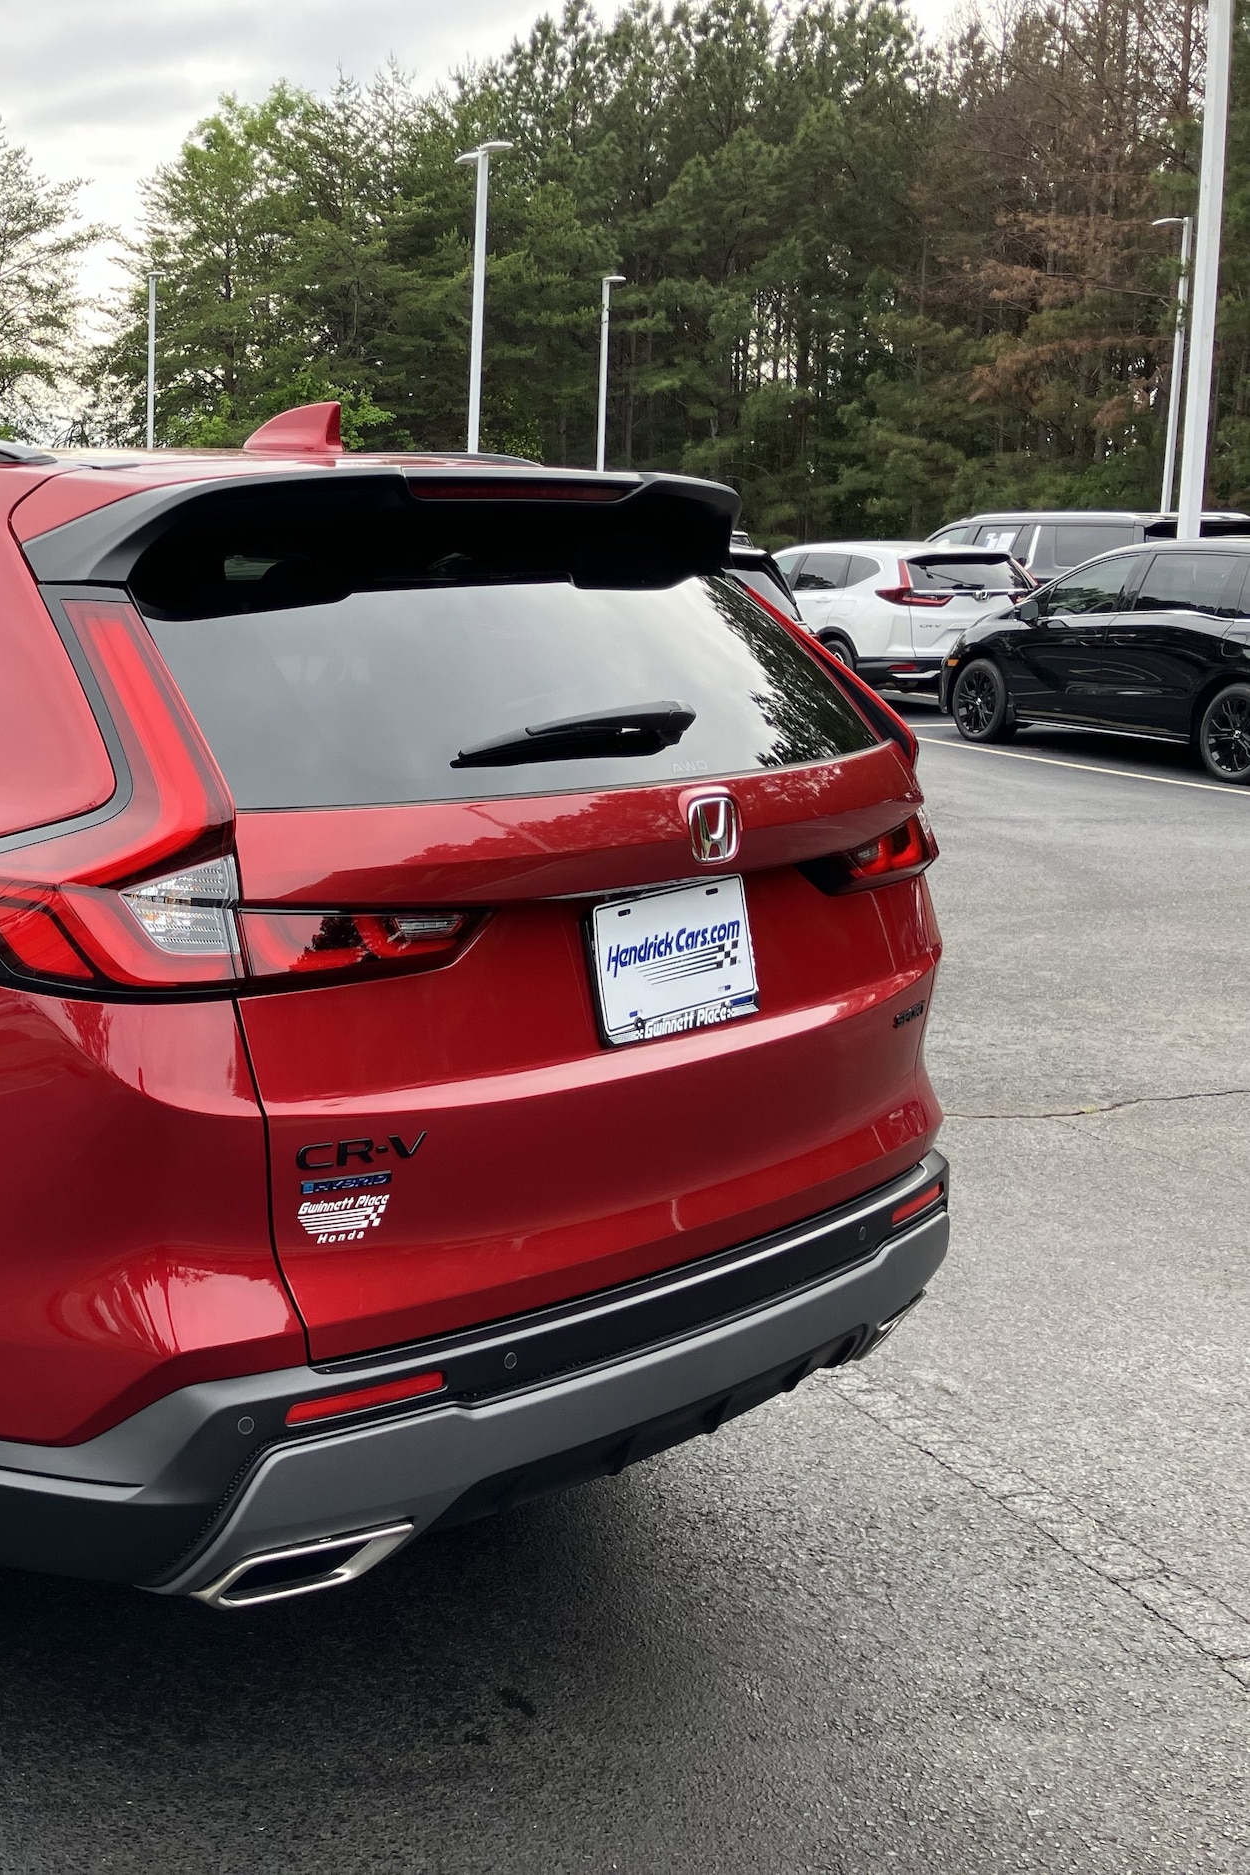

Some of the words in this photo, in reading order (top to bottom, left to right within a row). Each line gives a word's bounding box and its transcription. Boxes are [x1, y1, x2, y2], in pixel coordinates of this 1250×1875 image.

[672, 760, 709, 774] AWD
[606, 931, 675, 978] Hendrick
[675, 920, 740, 953] Cars.com
[645, 1012, 696, 1039] Gwinnett
[696, 1006, 727, 1027] Place
[296, 1130, 428, 1170] CR-V
[314, 1174, 388, 1192] HYBRID
[297, 1196, 355, 1215] Gwinnett
[355, 1194, 390, 1208] Place
[316, 1230, 365, 1244] Honda
